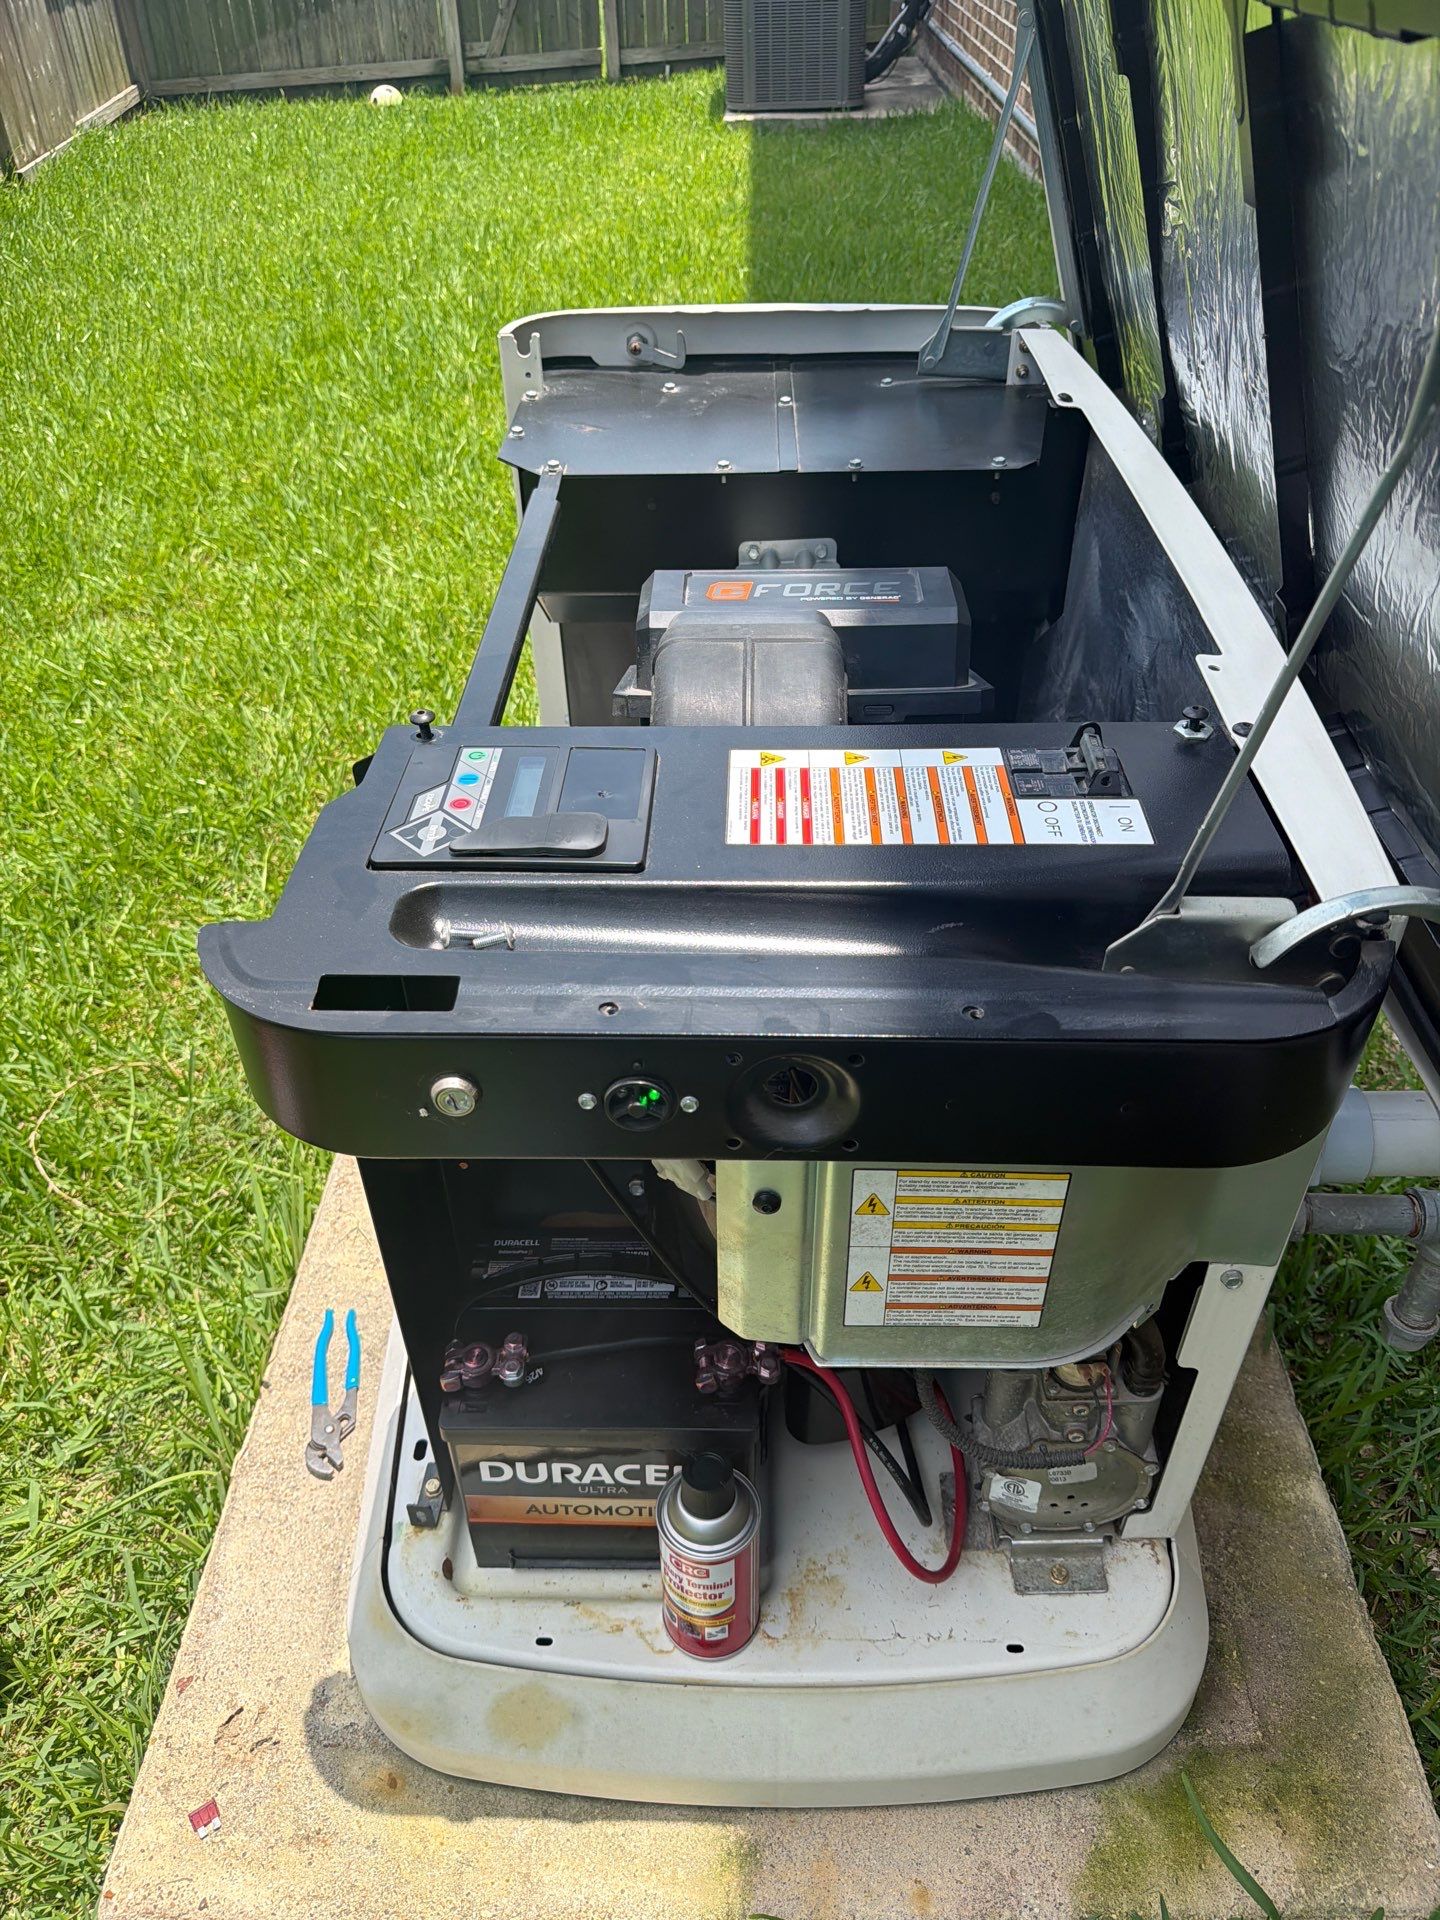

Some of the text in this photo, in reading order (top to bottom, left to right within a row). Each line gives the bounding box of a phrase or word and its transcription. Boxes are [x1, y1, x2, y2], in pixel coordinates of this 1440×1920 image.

[754, 582, 900, 597] FORCE
[1006, 797, 1016, 816] WARNING
[1044, 817, 1062, 838] OFF
[1118, 817, 1136, 832] ON
[526, 1504, 656, 1517] AUTOMOTI
[670, 1556, 708, 1578] CRC
[686, 1578, 733, 1590] Terminal
